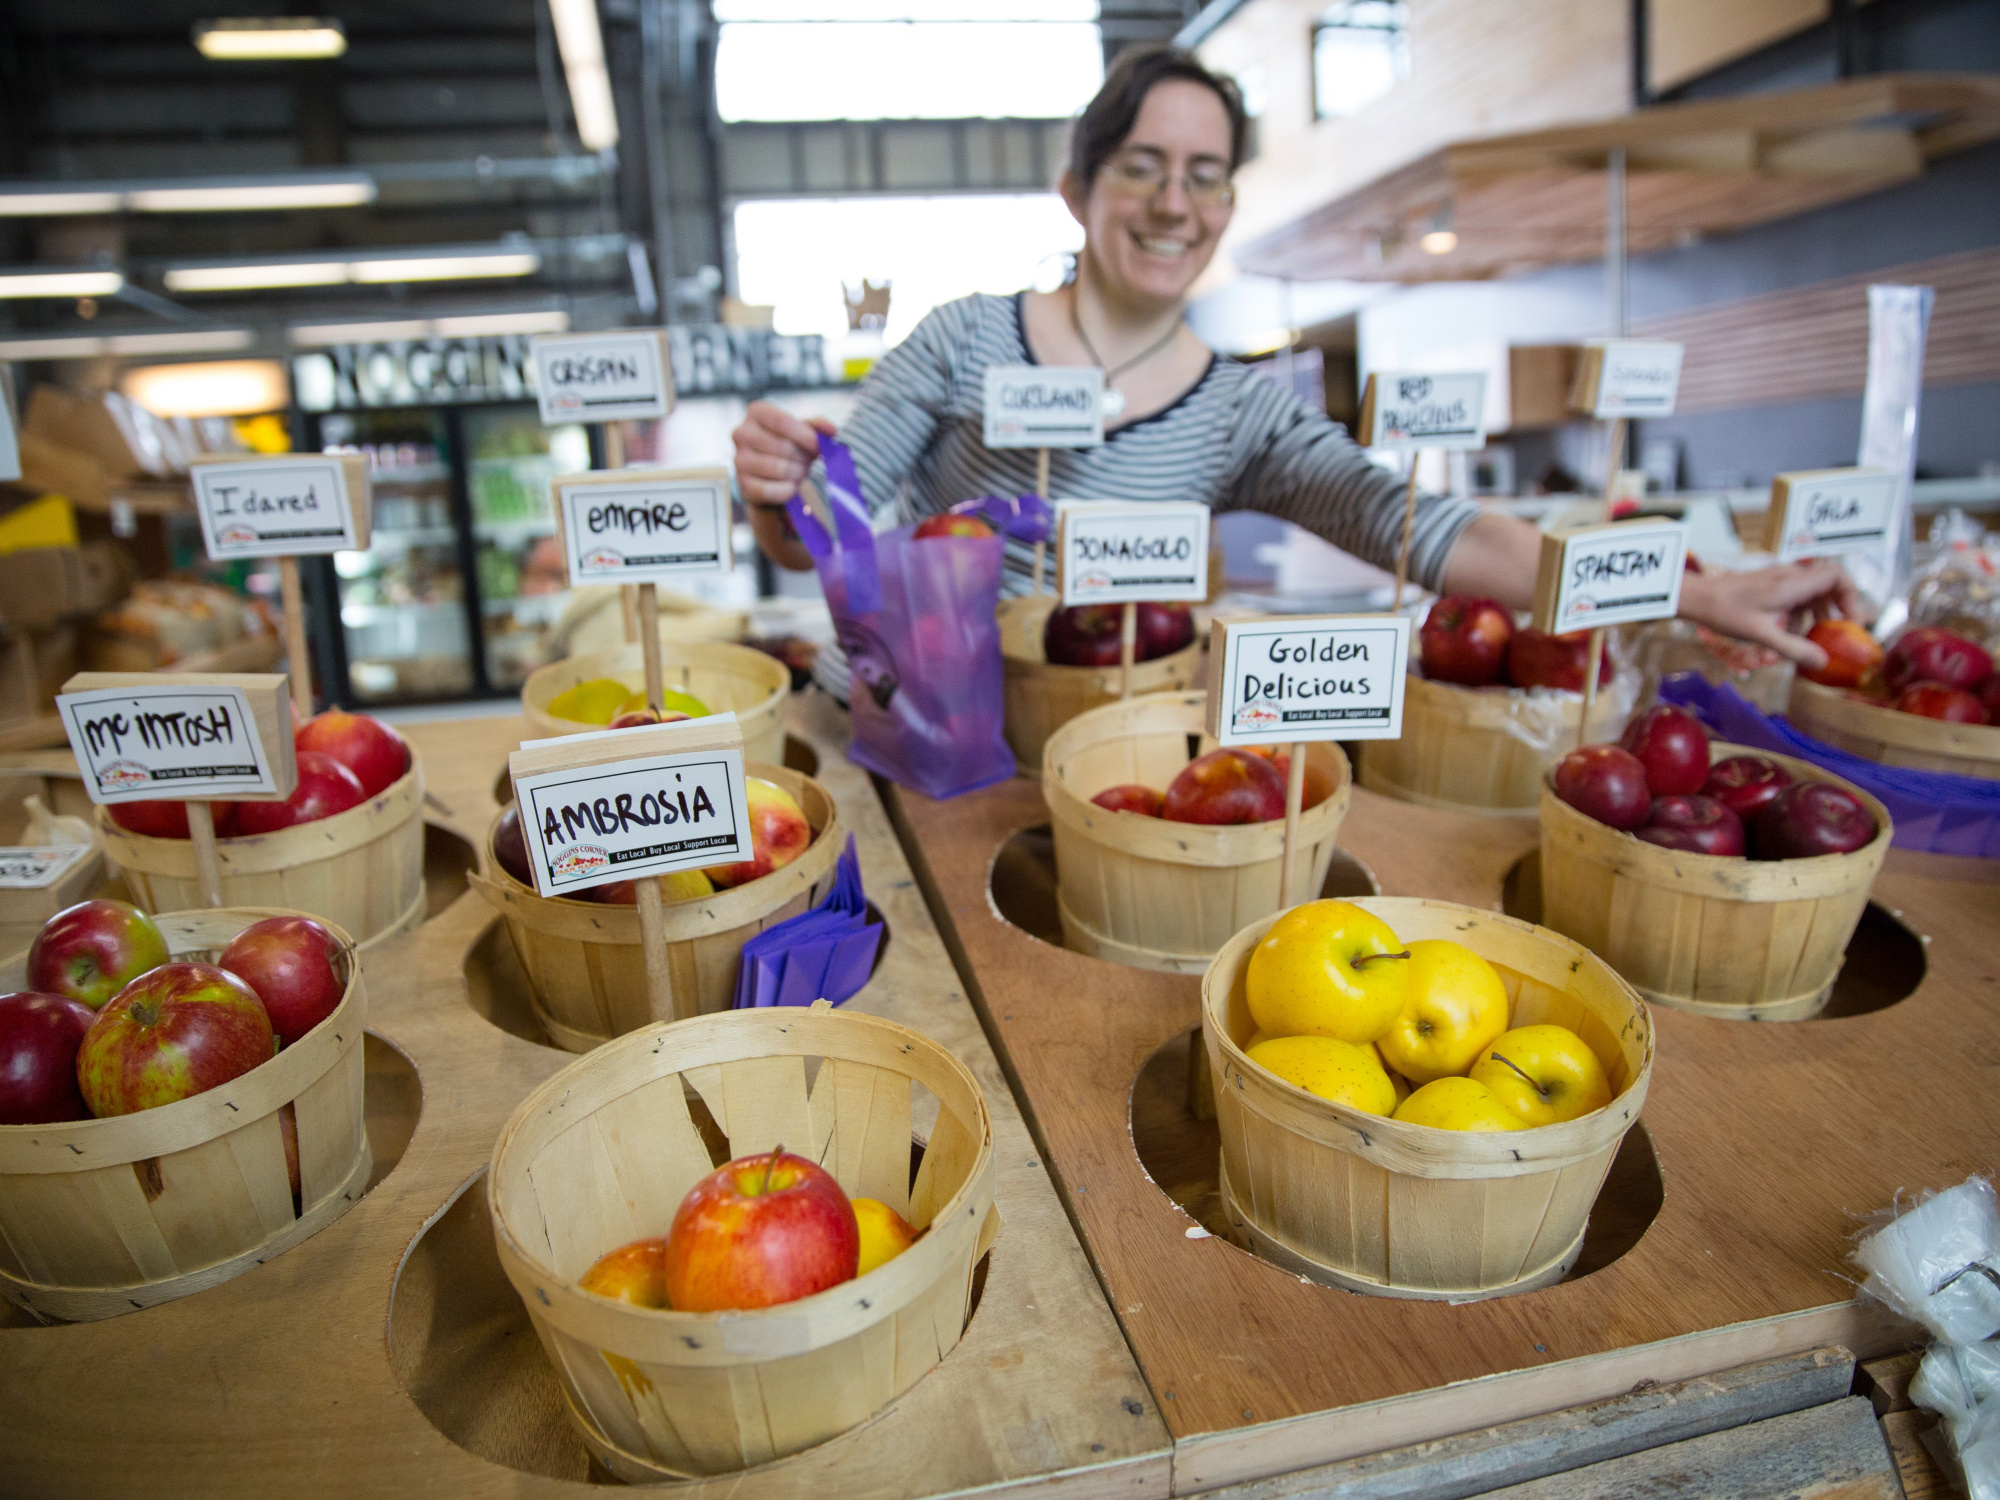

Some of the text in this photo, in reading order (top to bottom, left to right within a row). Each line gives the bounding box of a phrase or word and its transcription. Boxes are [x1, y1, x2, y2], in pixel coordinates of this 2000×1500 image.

[212, 484, 319, 515] Idared
[1573, 544, 1666, 588] SPARTAN
[1269, 636, 1370, 663] Golden
[1244, 673, 1371, 702] Delicious
[579, 845, 608, 858] CORNER
[616, 836, 728, 861] Eat Local Buy Local Support Local
